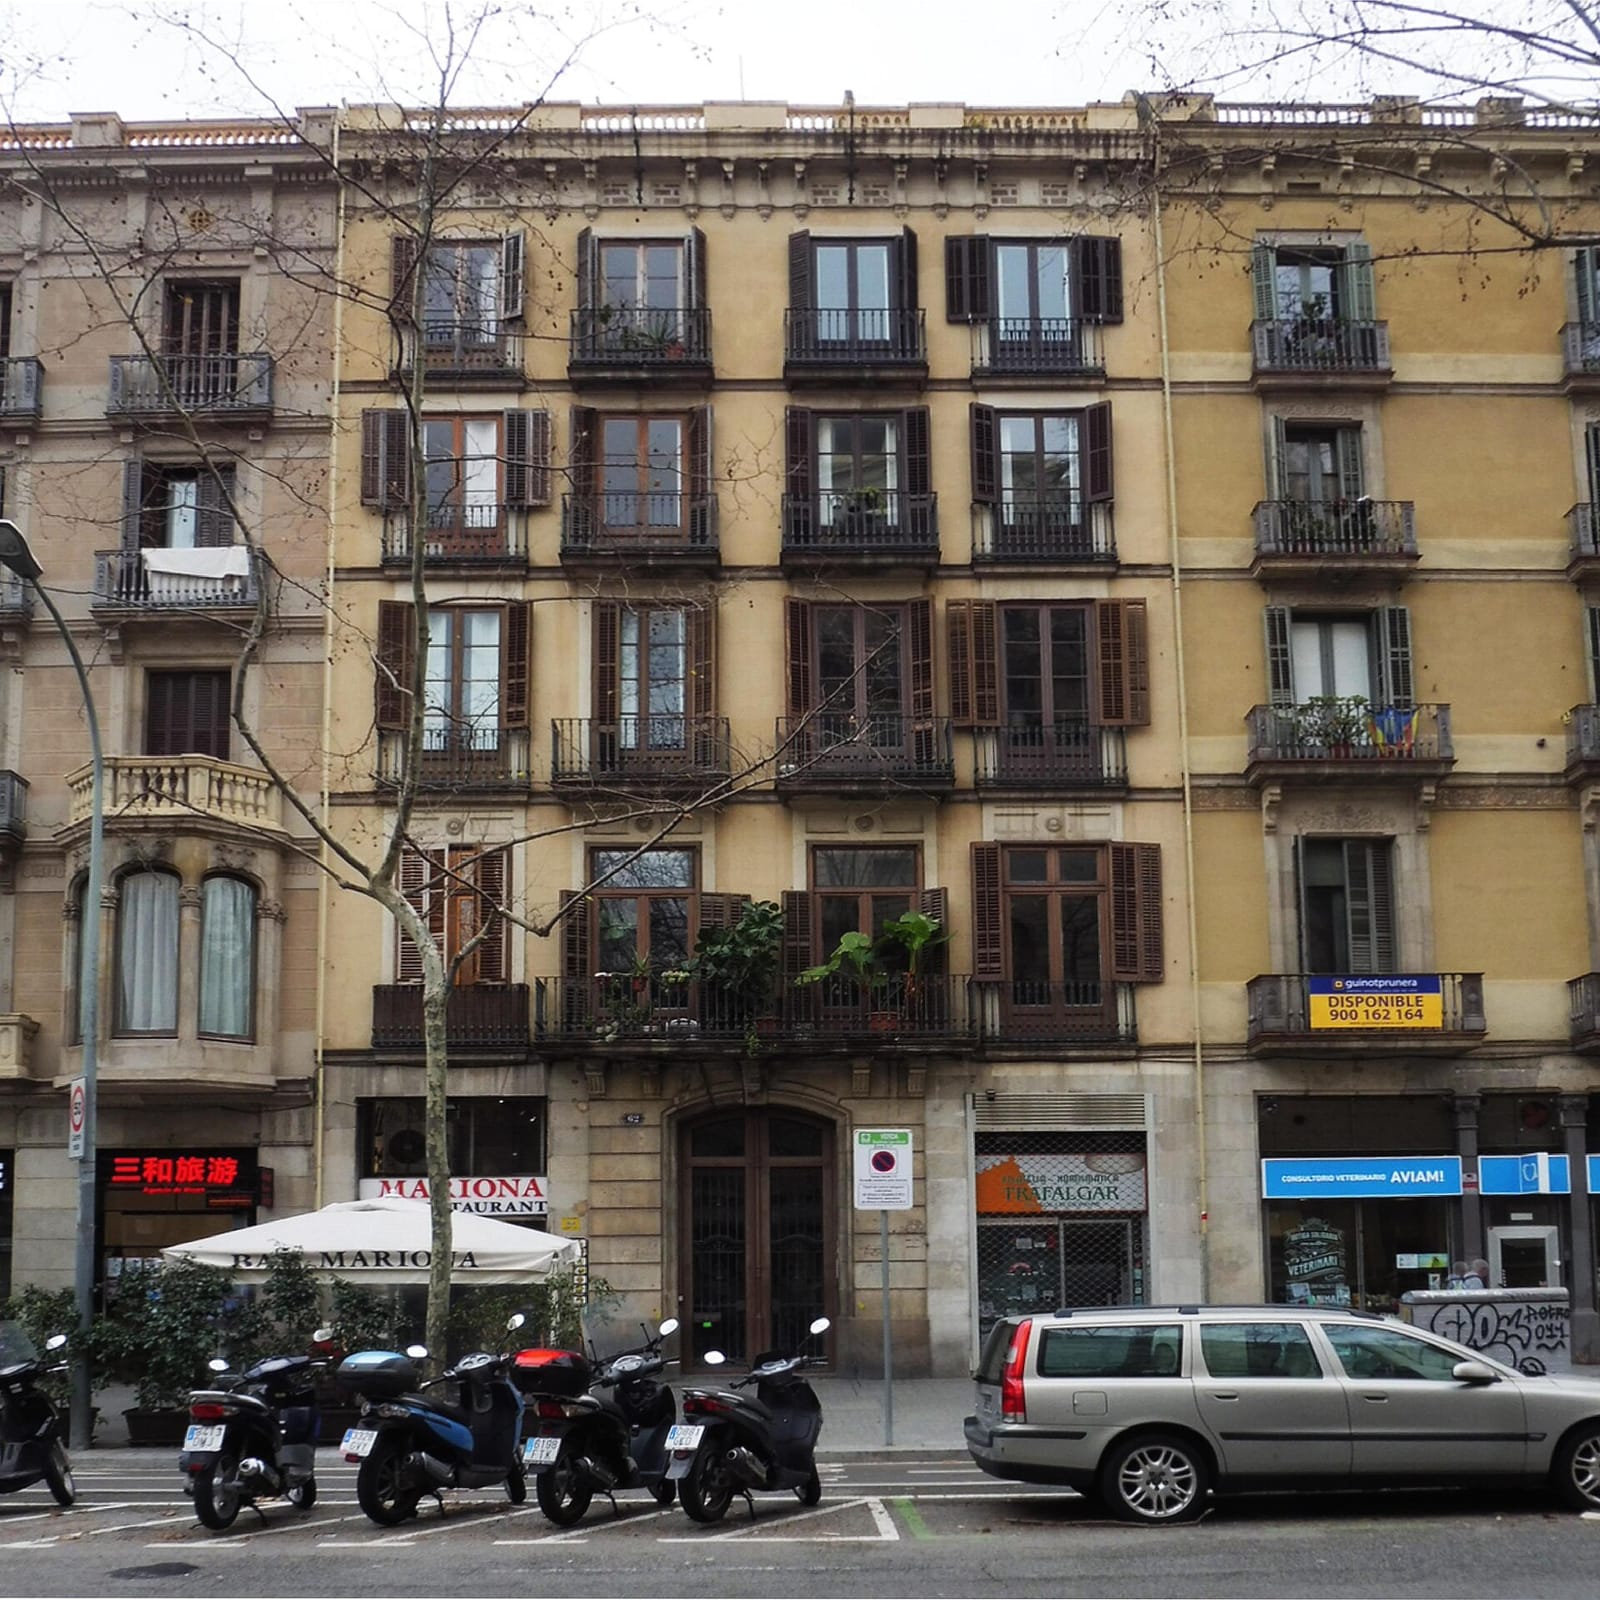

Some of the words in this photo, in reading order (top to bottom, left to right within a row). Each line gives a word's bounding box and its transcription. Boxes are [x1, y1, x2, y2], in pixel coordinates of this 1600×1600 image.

[1345, 979, 1418, 989] guinotprunera
[1328, 996, 1424, 1008] DISPONIBLE
[1329, 1009, 1358, 1020] 900
[1364, 1009, 1391, 1020] 162
[1397, 1009, 1424, 1020] 164
[112, 1157, 238, 1184] 三和旅游
[1390, 1170, 1444, 1184] AVIAM!
[379, 1178, 544, 1198] MAIONA
[1004, 1186, 1119, 1200] TRAFALGAR
[319, 1250, 479, 1268] MARIOA
